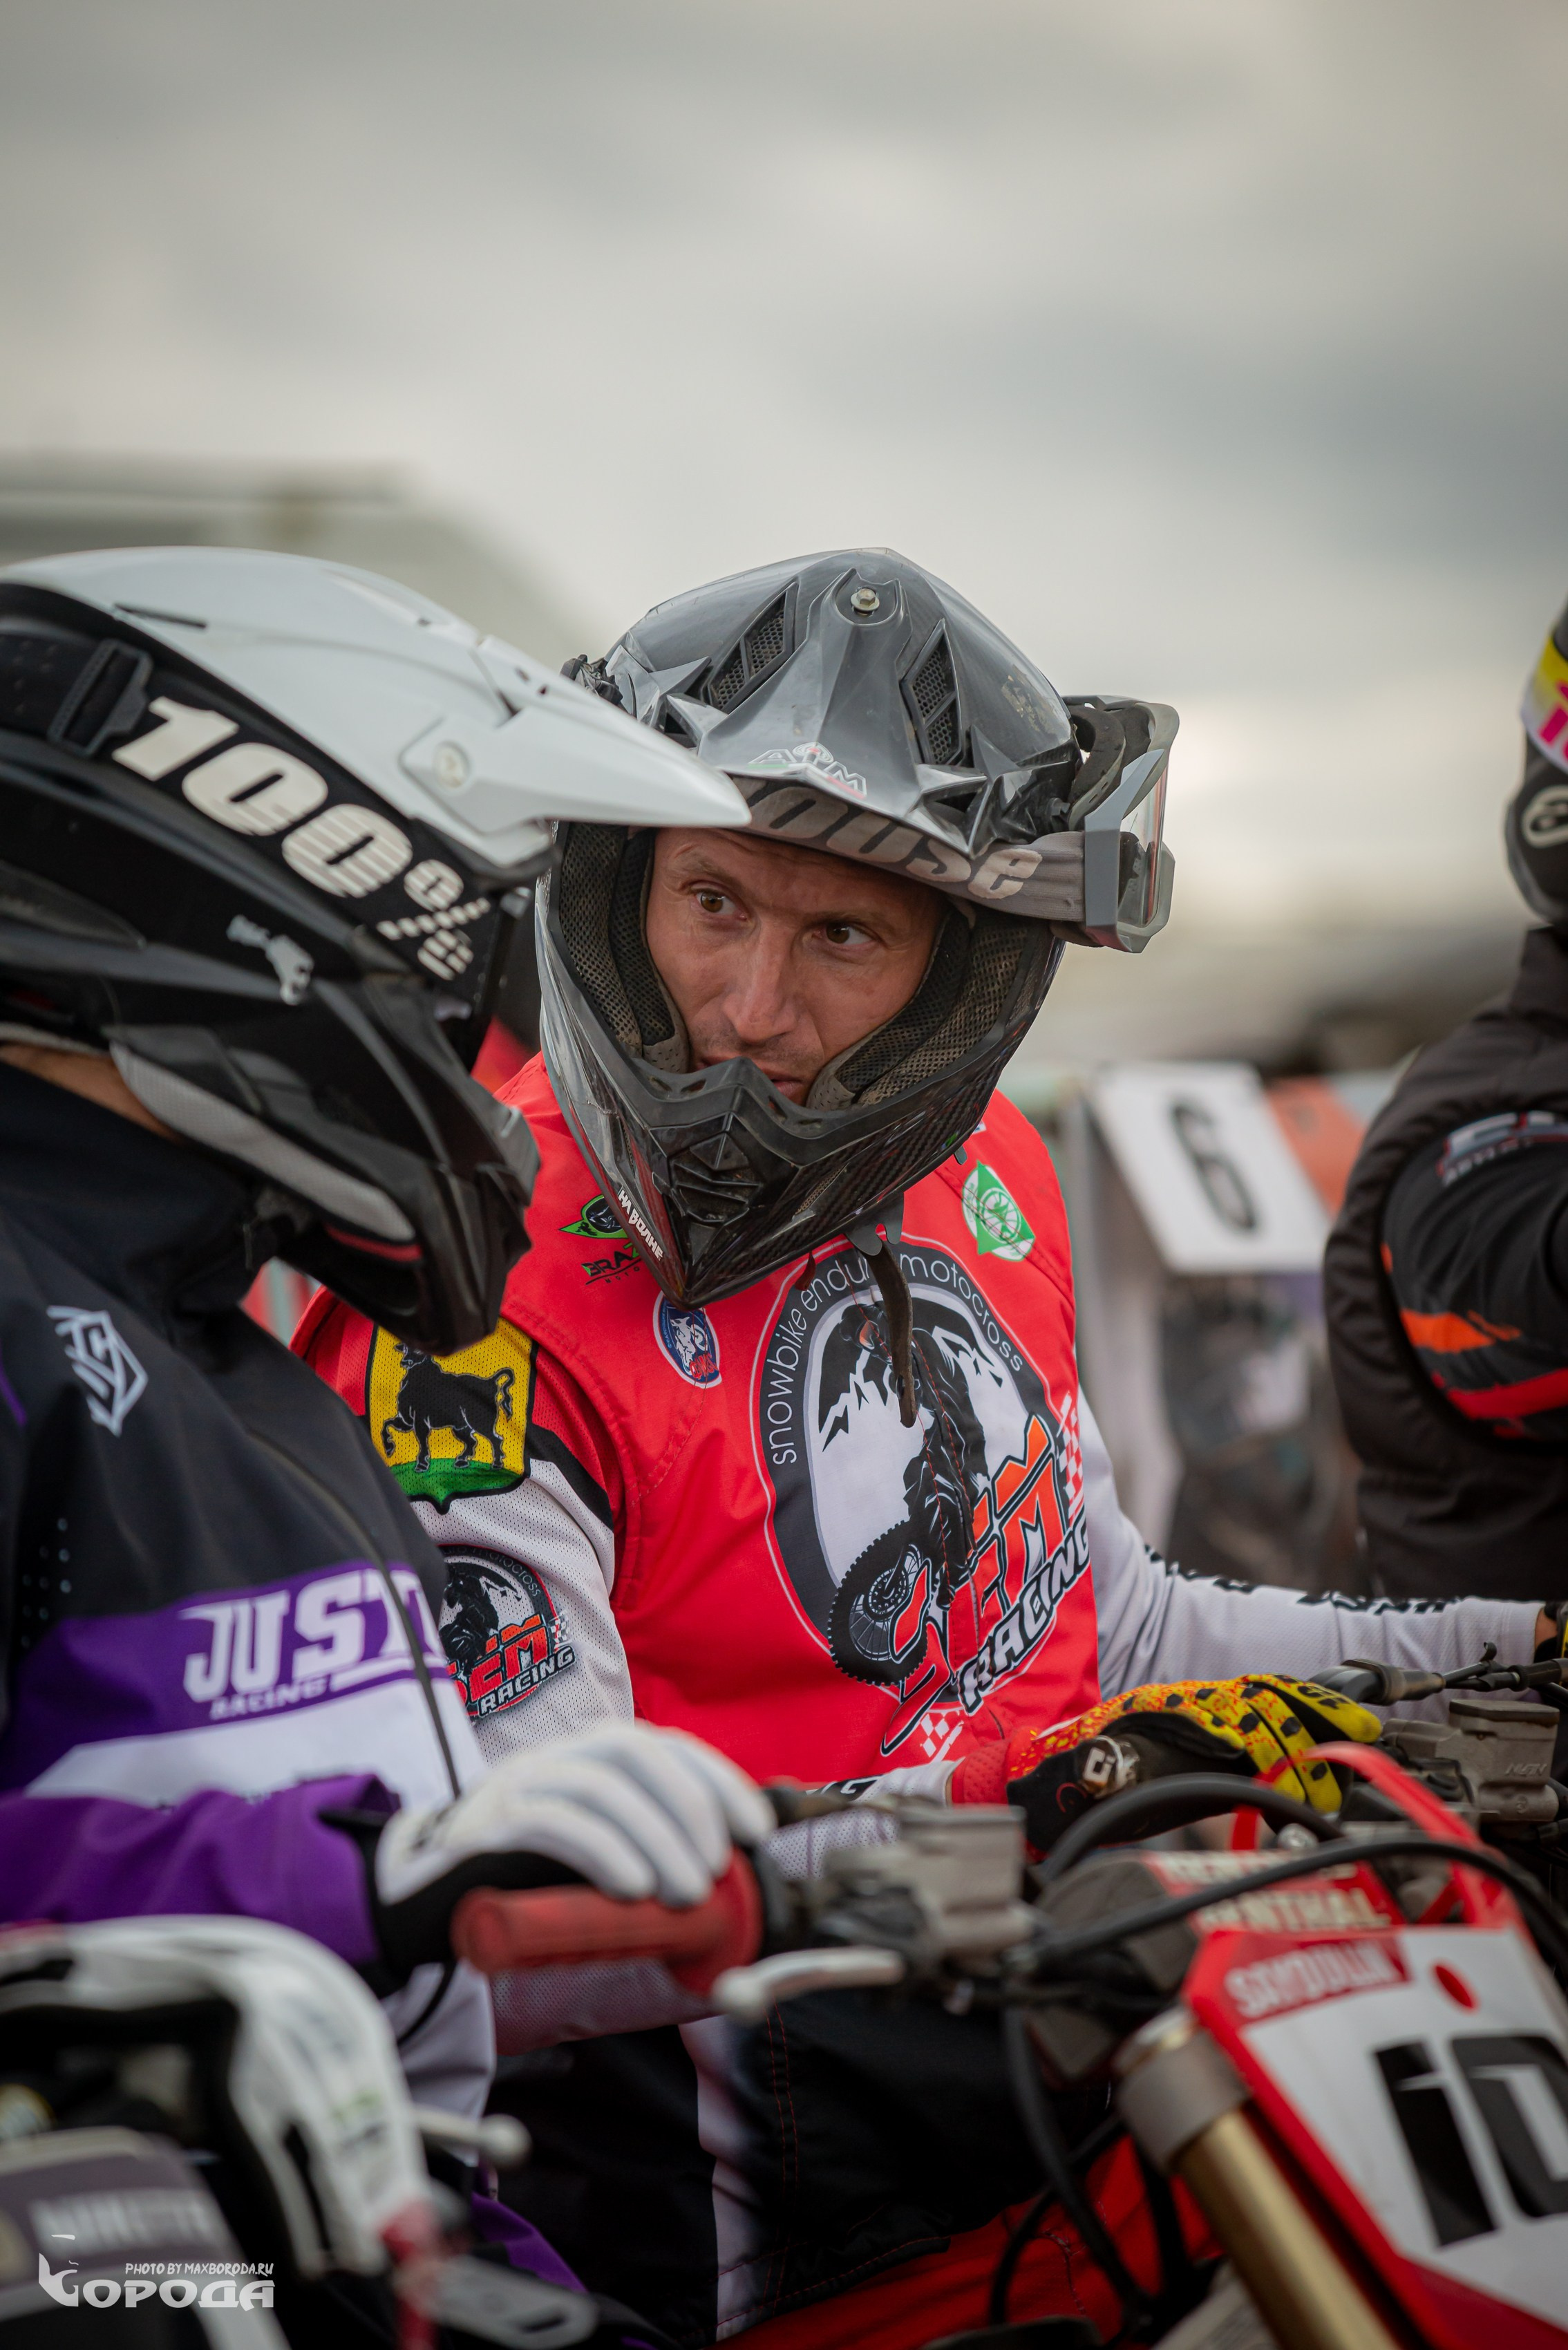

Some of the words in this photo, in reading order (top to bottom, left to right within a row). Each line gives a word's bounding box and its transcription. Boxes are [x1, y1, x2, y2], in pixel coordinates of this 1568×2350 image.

[113, 696, 491, 980] 100%
[766, 1308, 807, 1465] snowbike
[800, 1257, 872, 1312] endur
[900, 1254, 1023, 1372] motocross
[478, 1645, 576, 1718] RACING
[957, 1510, 1090, 1716] RACING
